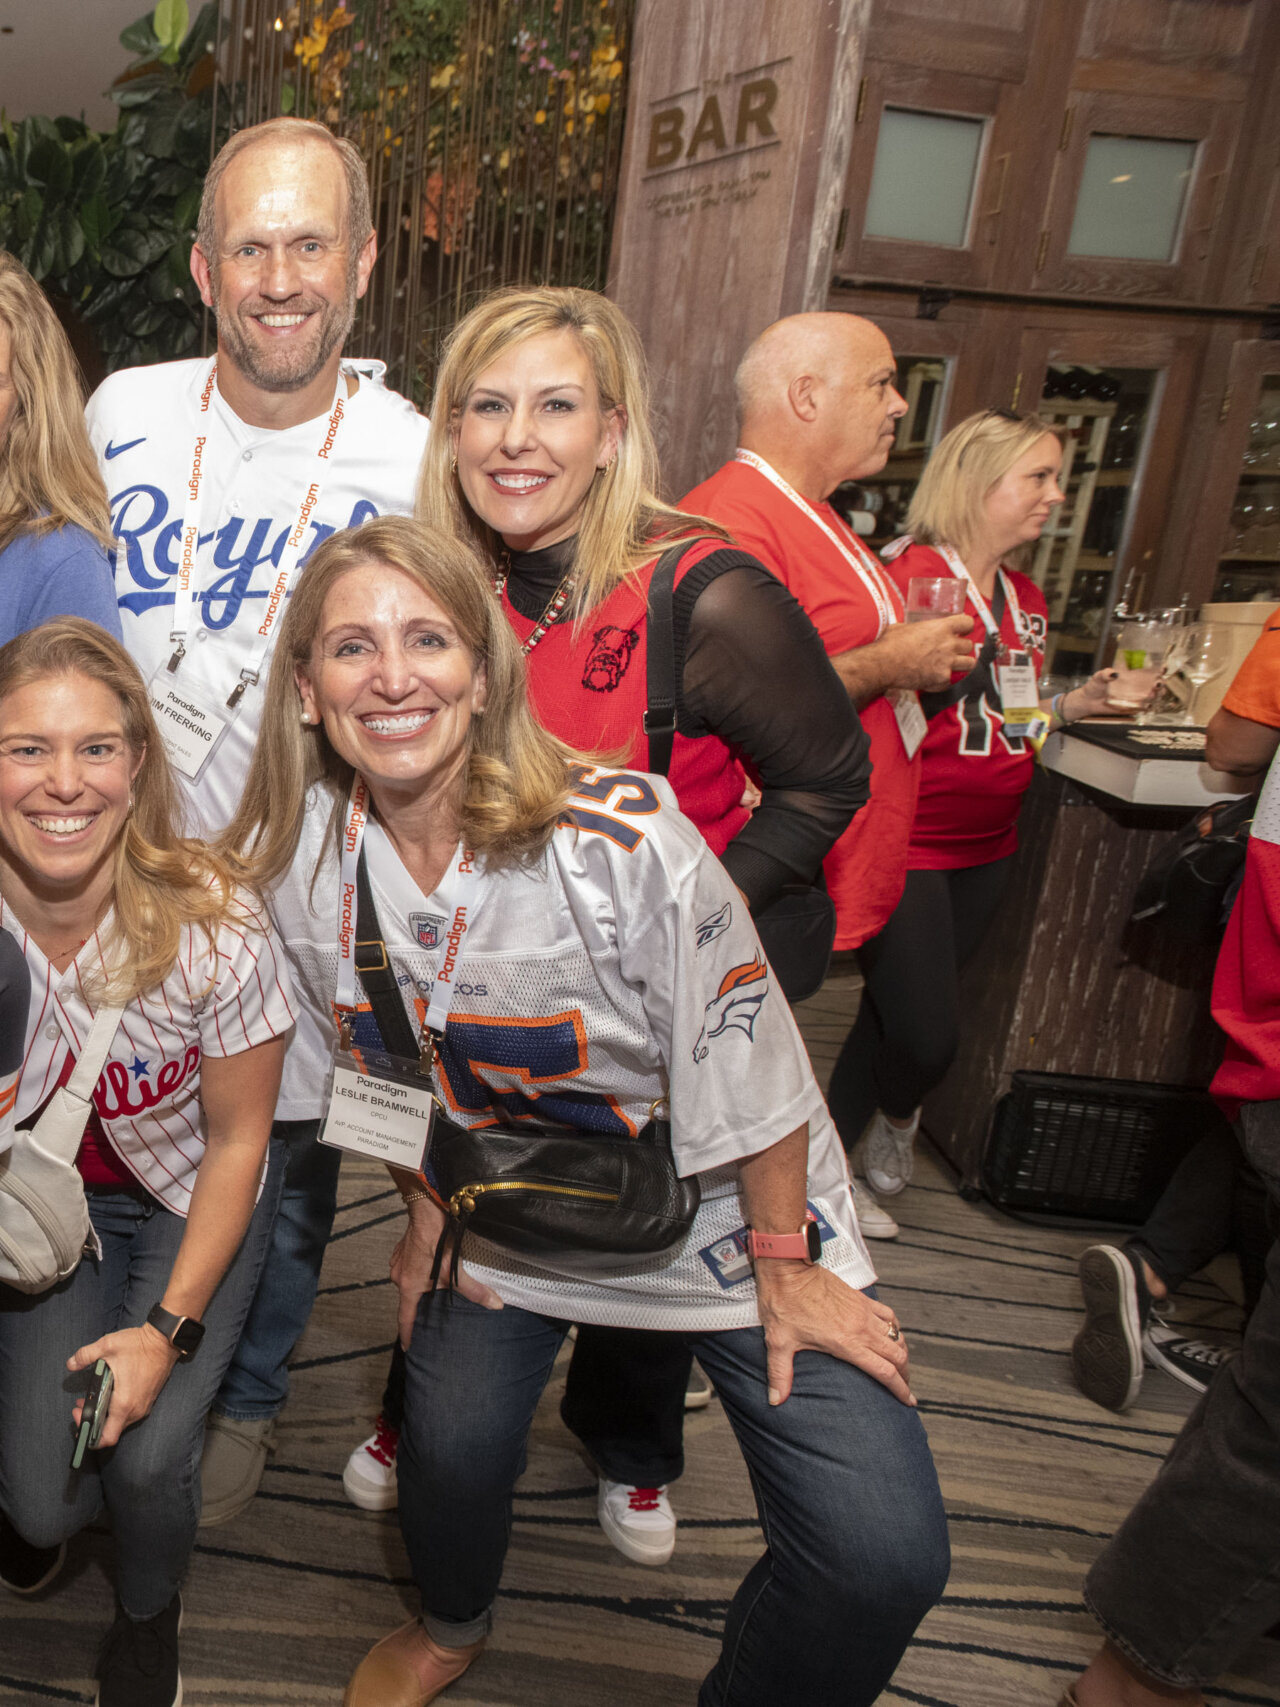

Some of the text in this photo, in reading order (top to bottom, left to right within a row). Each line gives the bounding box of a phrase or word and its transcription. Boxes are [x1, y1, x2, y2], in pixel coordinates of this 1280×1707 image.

[646, 77, 779, 169] BAR
[318, 398, 345, 459] Paradigm
[188, 436, 207, 501] Paradigm
[288, 483, 319, 548] Paradigm
[179, 526, 197, 591] Paradigm
[258, 571, 288, 636] Paradigm
[167, 691, 206, 720] Paradigm
[164, 706, 213, 742] FRERKING
[554, 761, 661, 854] 15
[338, 882, 355, 959] Paradigm
[411, 914, 446, 926] EQUIPMENT
[419, 932, 436, 945] NFL
[437, 906, 467, 983] Paradigm
[397, 974, 489, 997] BOOS
[335, 1086, 428, 1120] LESLIE BRAMWELL
[356, 1075, 408, 1098] Paradigm
[370, 1111, 388, 1121] CPCU
[347, 1123, 374, 1137] ACCOUNT
[375, 1131, 417, 1149] MANAGEMENT
[357, 1136, 389, 1151] PARADIGM
